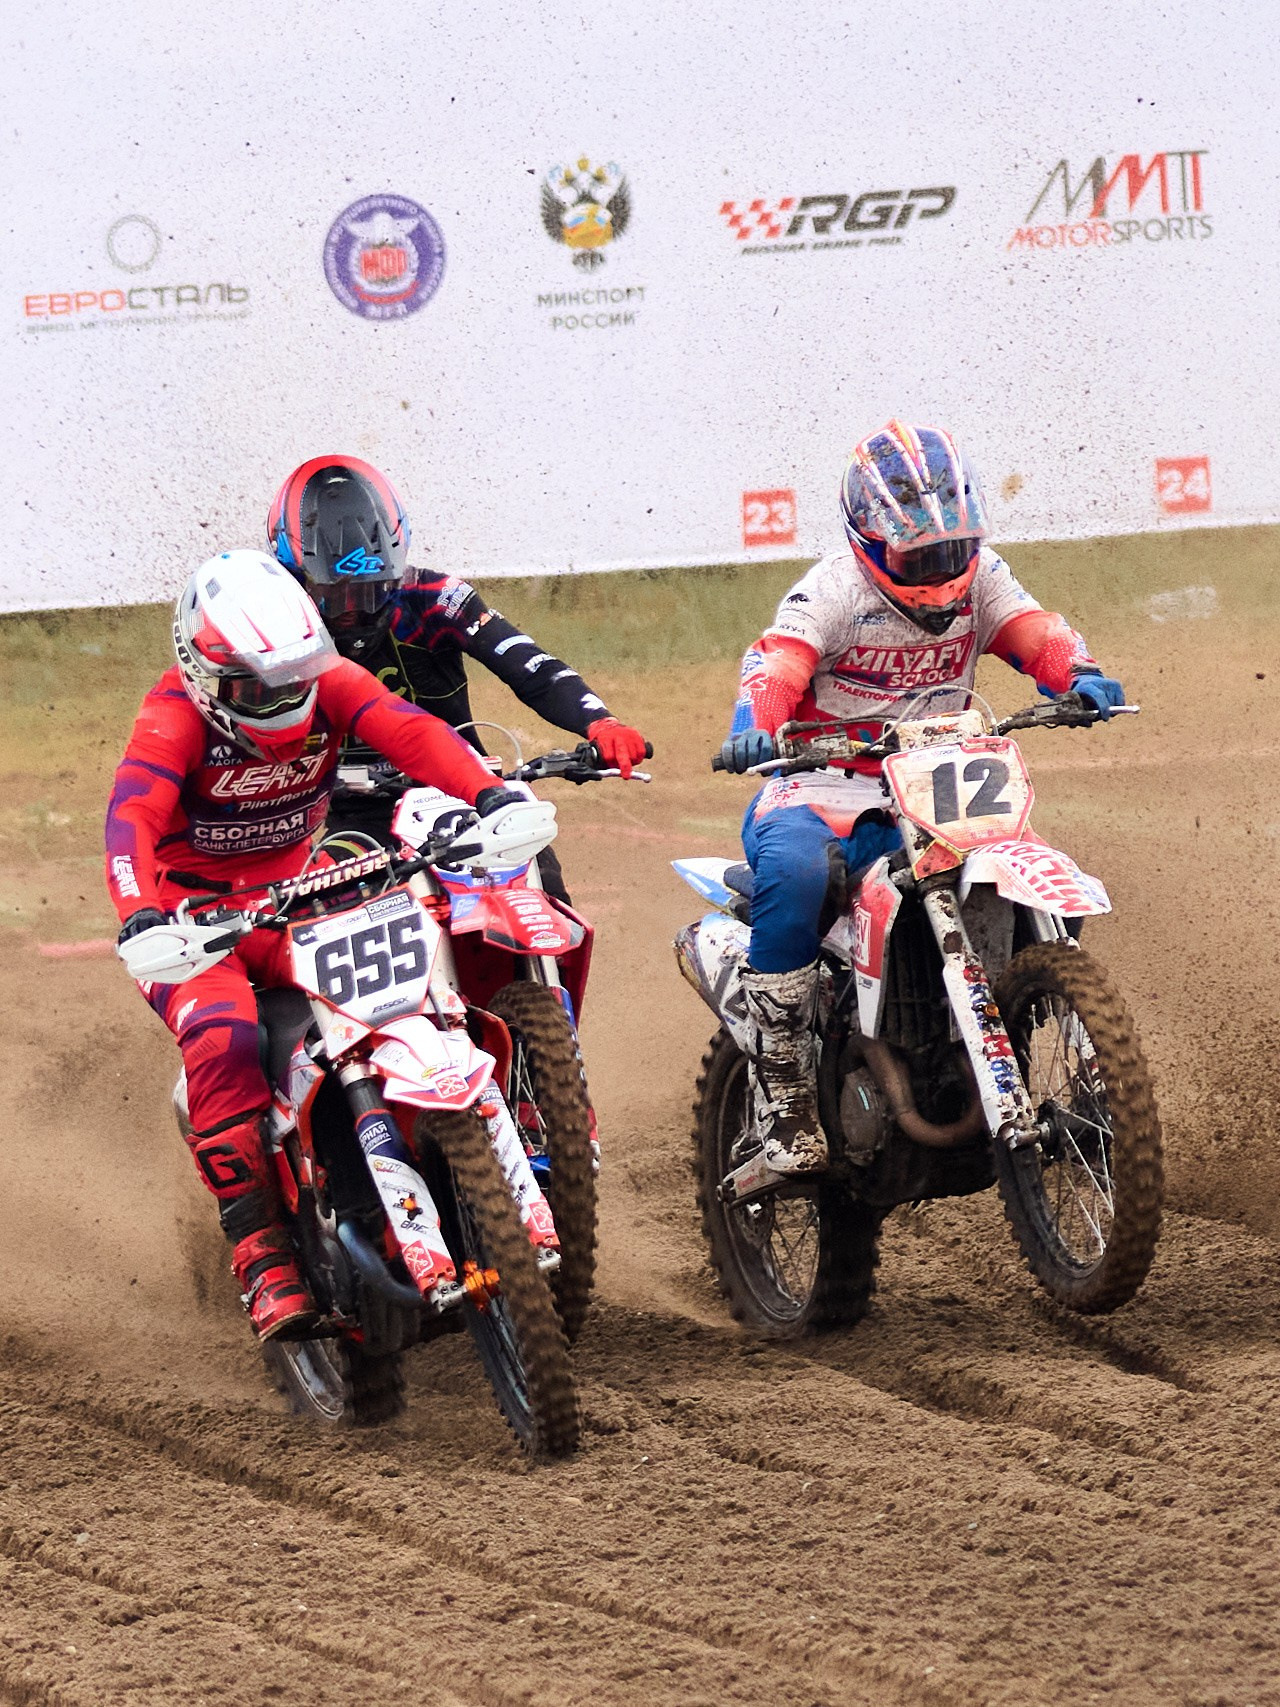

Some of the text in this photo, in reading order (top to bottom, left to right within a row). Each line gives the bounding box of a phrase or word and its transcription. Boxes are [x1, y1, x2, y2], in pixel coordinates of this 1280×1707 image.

[785, 186, 956, 237] RGP
[1006, 214, 1214, 251] MOTORSPORTS
[24, 282, 250, 318] ЕВРОСТАЛЬ
[535, 286, 648, 308] МИНСПОРТ
[549, 310, 637, 332] РОССИИ
[1160, 466, 1208, 500] 24
[744, 502, 794, 536] 23
[931, 757, 1013, 826] 12
[193, 826, 306, 851] САНКТ-ПЕТЕРБУРГА
[194, 811, 304, 842] СБОРНАЯ
[314, 911, 428, 1006] 655
